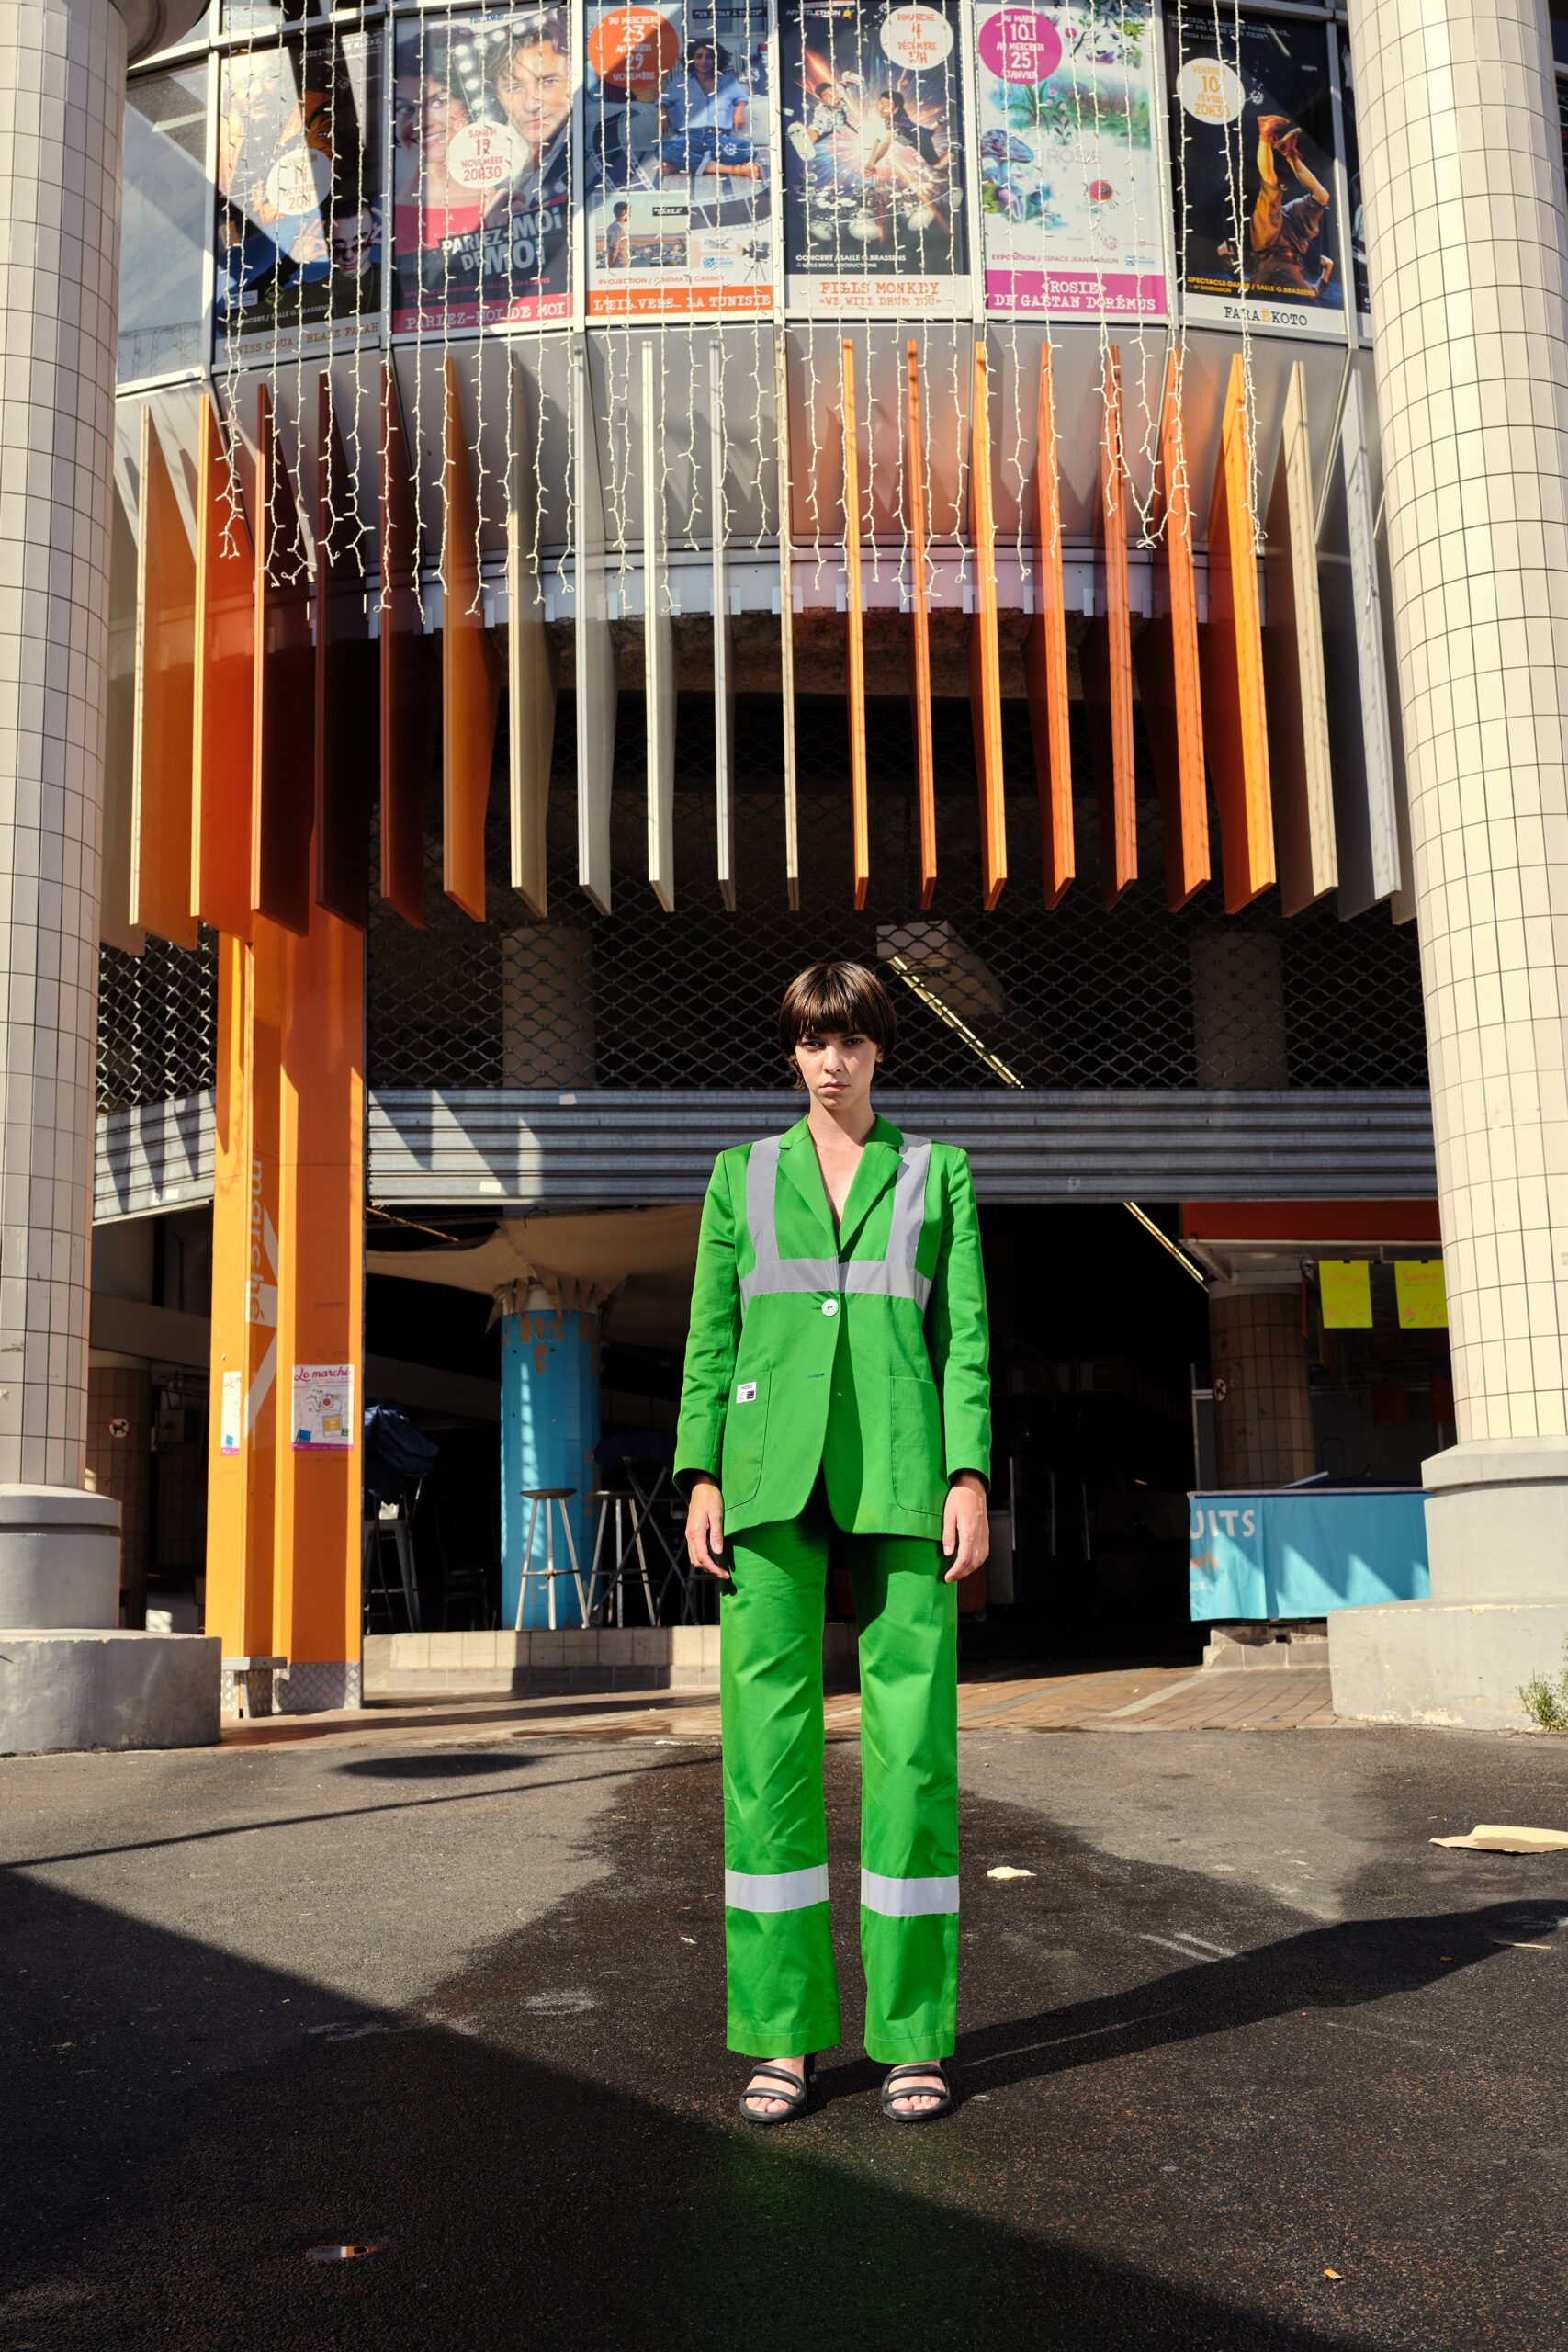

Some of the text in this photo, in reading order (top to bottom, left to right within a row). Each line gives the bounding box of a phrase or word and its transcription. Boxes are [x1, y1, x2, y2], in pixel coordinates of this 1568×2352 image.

[622, 25, 645, 42] 23
[1010, 23, 1029, 40] 10
[1011, 51, 1032, 69] 25
[1202, 76, 1220, 93] 10
[1194, 103, 1231, 118] 20H30
[463, 166, 502, 182] 20H30
[875, 282, 940, 294] MONKEY
[709, 295, 771, 307] TUNISIE
[845, 297, 874, 306] WILL
[879, 297, 909, 306] DRUM
[511, 306, 532, 320] DE
[536, 302, 566, 317] MOI
[232, 316, 265, 326] CNCERT
[250, 1159, 265, 1321] marché
[294, 1366, 351, 1382] Le marché
